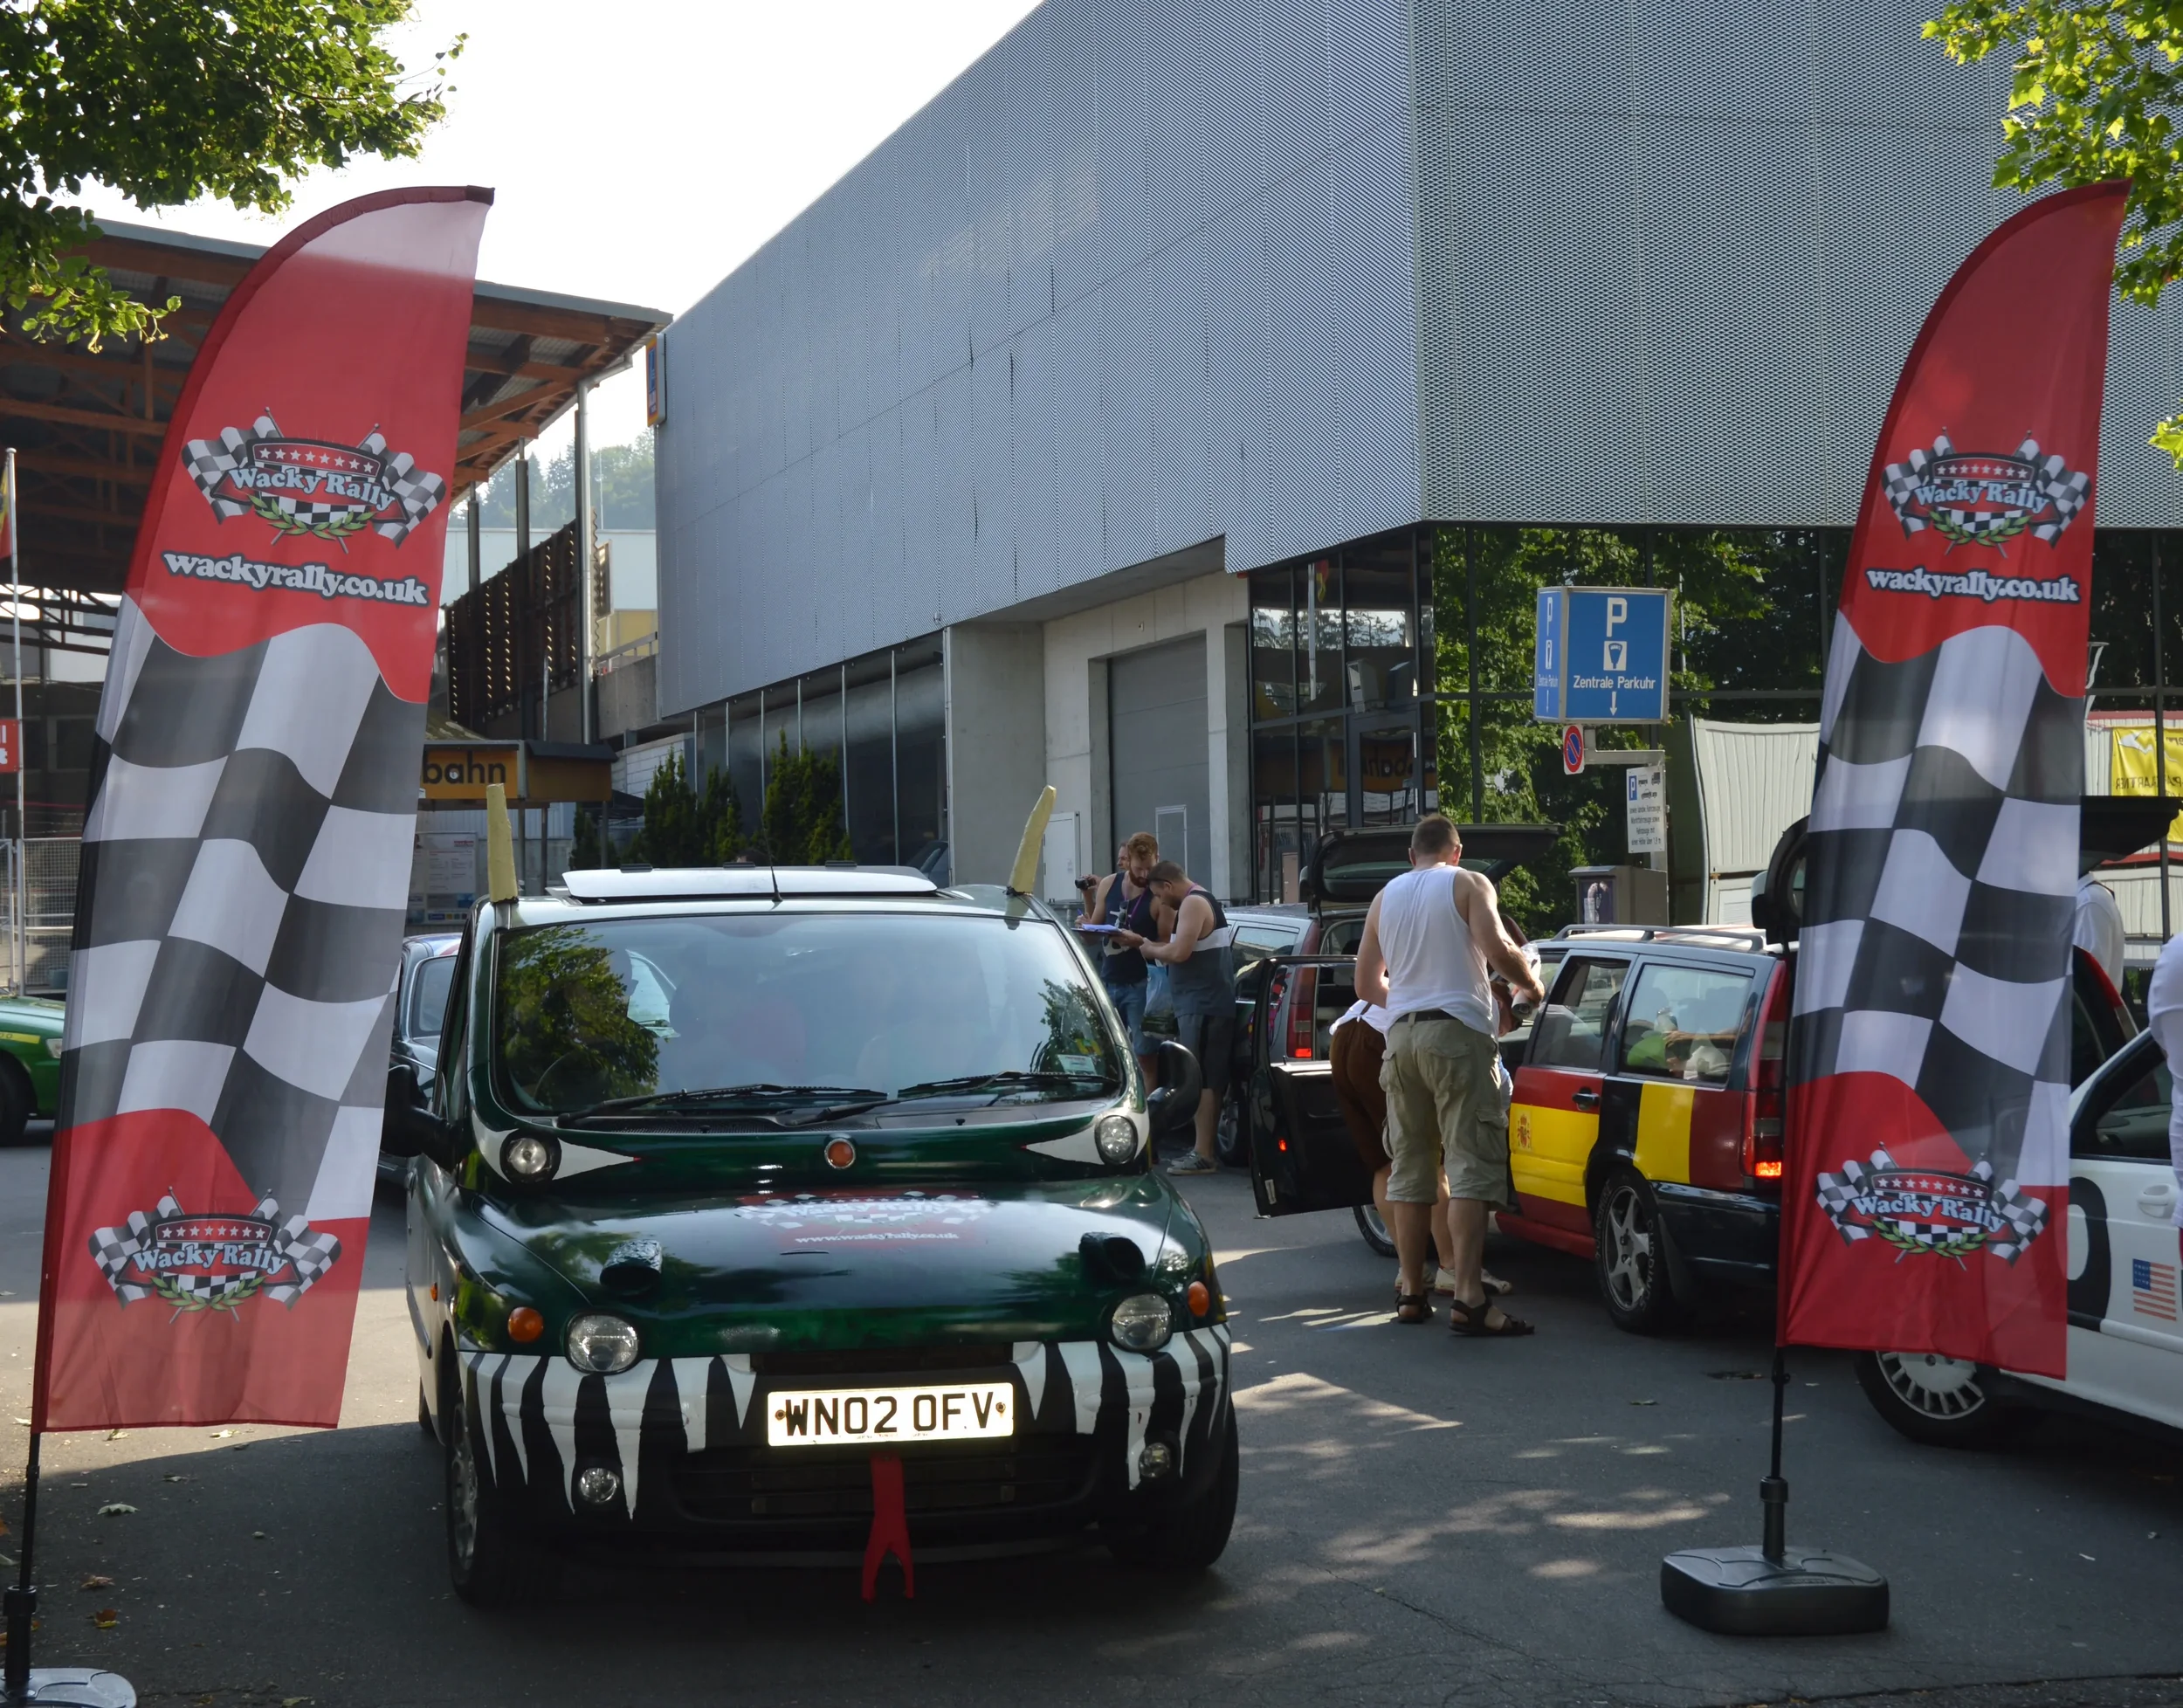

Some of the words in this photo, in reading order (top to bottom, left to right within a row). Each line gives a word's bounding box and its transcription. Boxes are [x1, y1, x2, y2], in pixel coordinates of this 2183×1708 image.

[229, 466, 323, 494] Wacky
[325, 472, 396, 511] Rally
[1913, 482, 1985, 506] Wacky
[1986, 482, 2050, 513] Rally
[162, 553, 428, 605] wackyrally.co.uk
[1865, 567, 2080, 602] wackyrally.co.uk
[1606, 596, 1628, 637] P
[1573, 675, 1614, 689] Zentrale
[1617, 676, 1656, 690] Parkuhr
[1851, 1195, 1936, 1217] Wacky
[1939, 1197, 2005, 1233] Rally
[132, 1244, 218, 1271] Wacky
[221, 1244, 288, 1275] Rally
[785, 1395, 898, 1436] WN02
[912, 1391, 994, 1432] OFV
